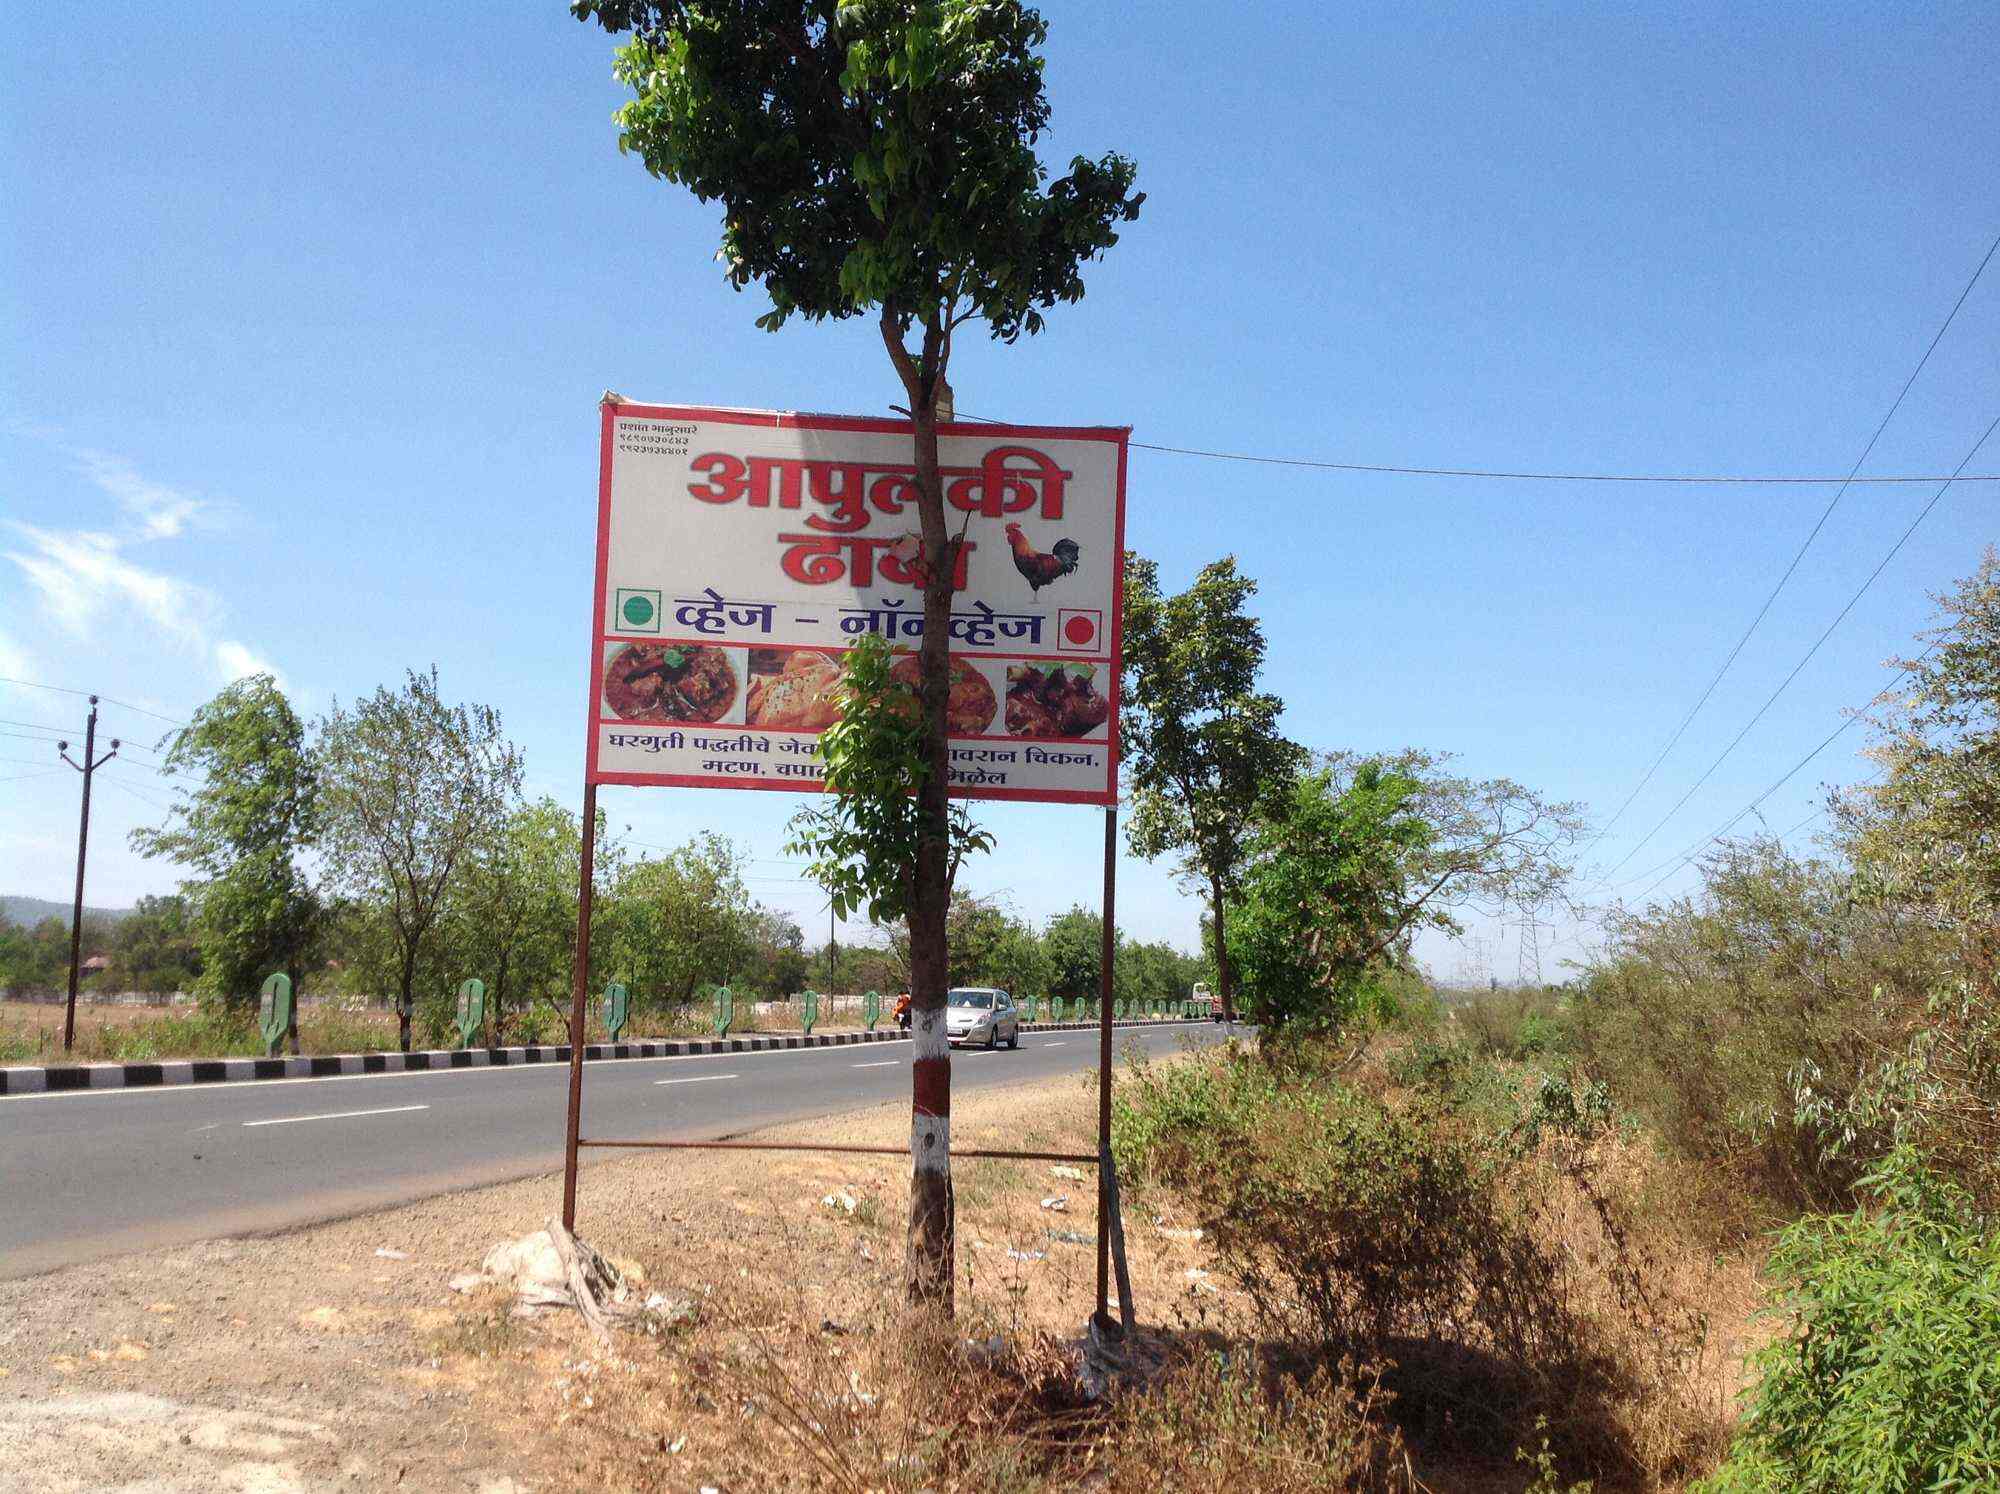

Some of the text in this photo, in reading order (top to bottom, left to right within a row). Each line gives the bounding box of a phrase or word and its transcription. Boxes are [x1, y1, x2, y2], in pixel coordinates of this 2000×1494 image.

[687, 446, 1073, 532] आपुलकी
[674, 587, 777, 634] व्हेज
[608, 732, 684, 752] घरगुती
[693, 735, 770, 754] पद्धतीचे
[778, 737, 820, 755] जेव
